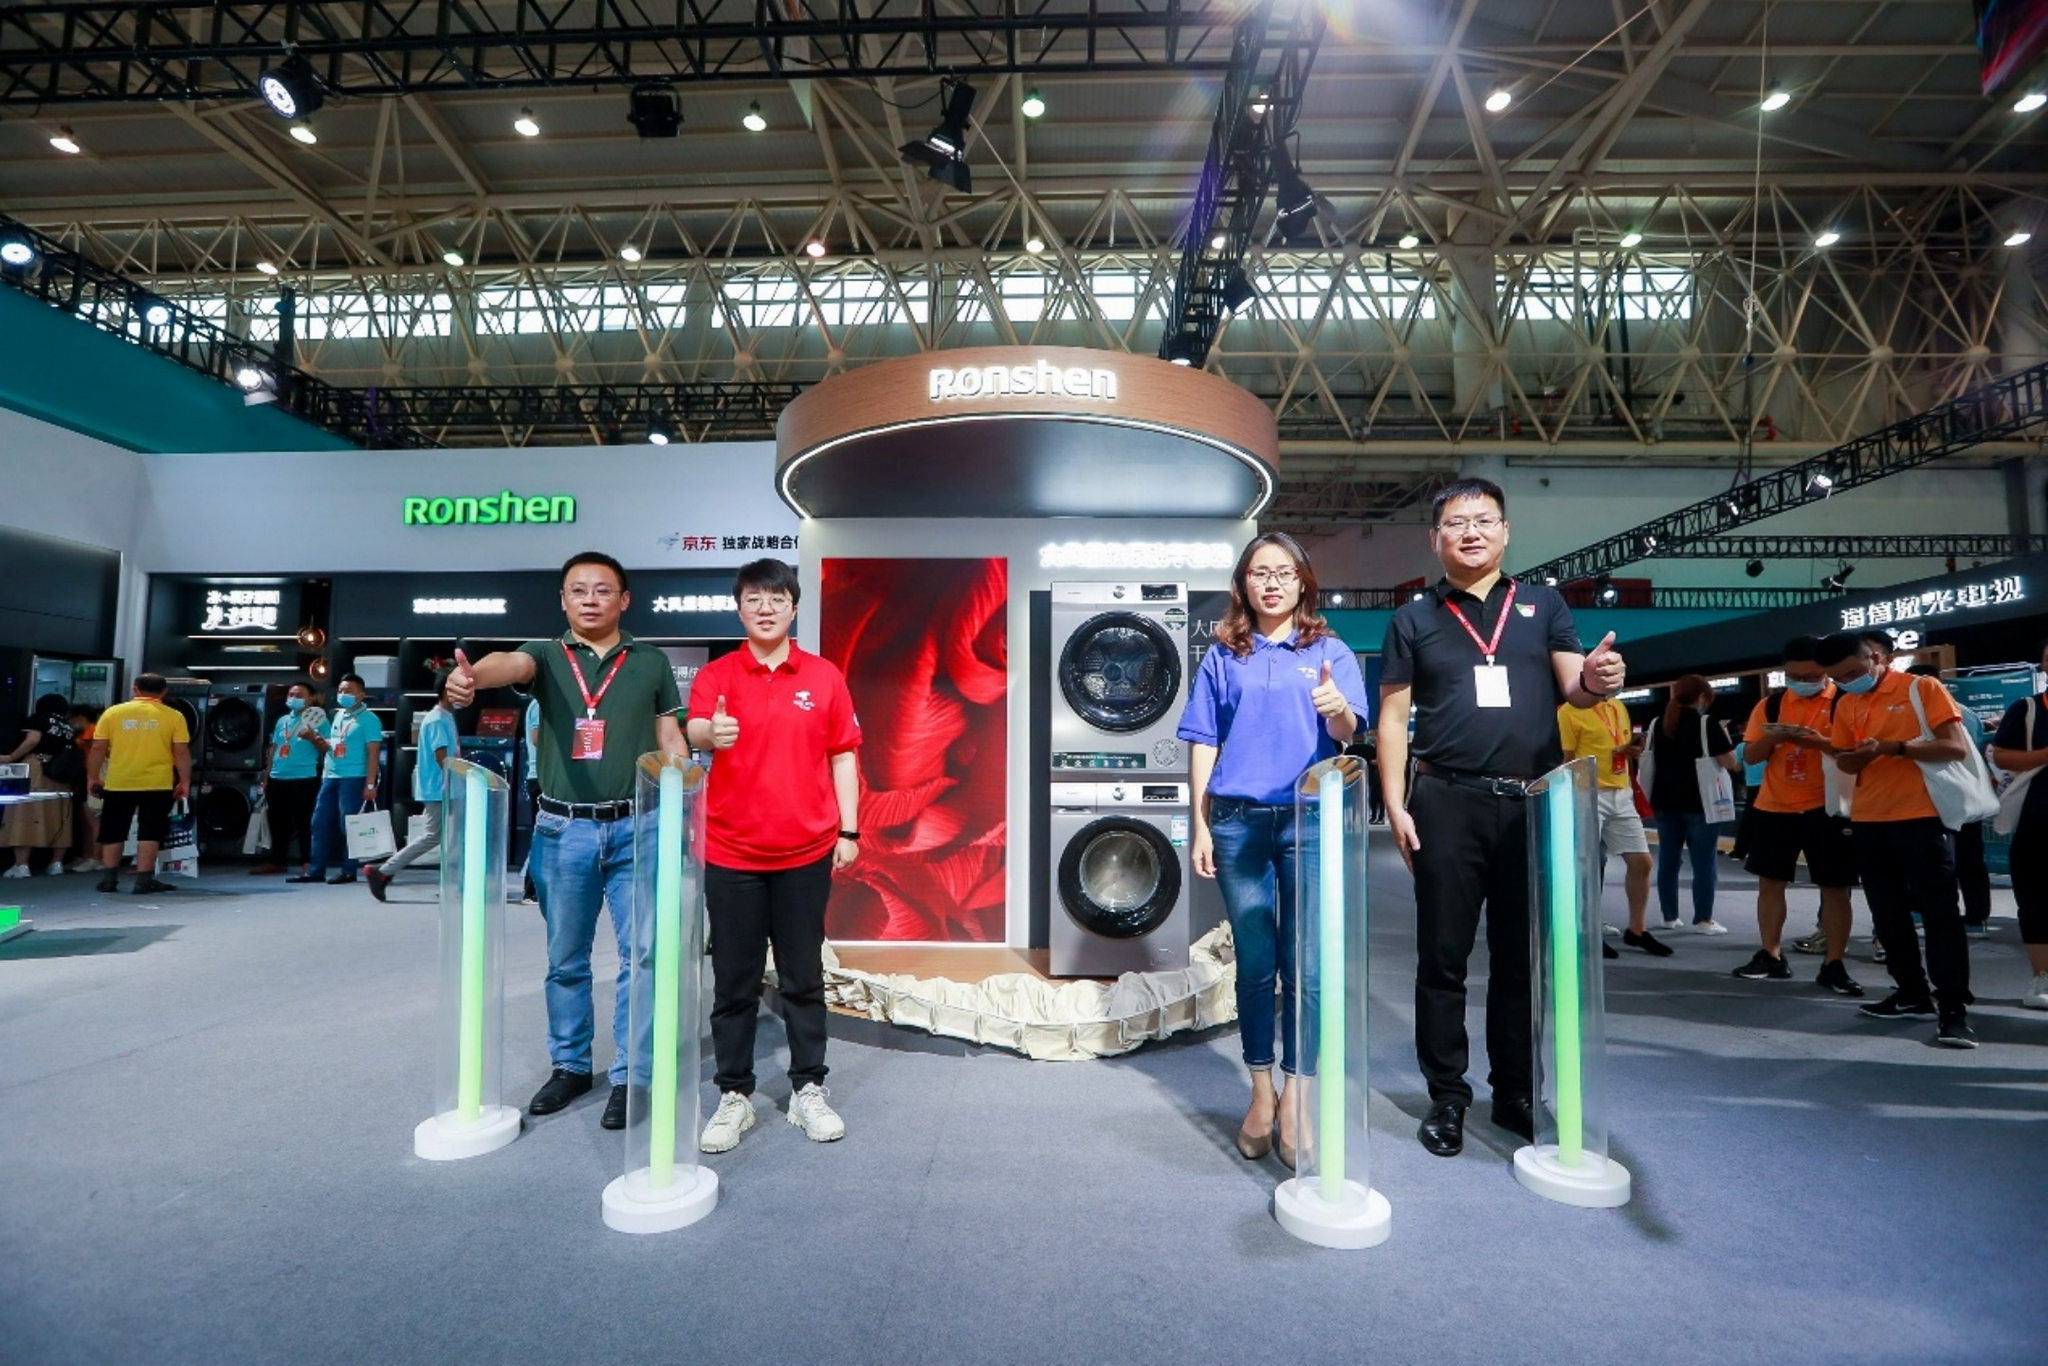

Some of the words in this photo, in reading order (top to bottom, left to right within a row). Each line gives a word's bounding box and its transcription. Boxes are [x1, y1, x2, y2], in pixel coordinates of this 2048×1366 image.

[682, 535, 717, 551] 京东
[722, 535, 799, 550] 独家战略合
[1840, 575, 2026, 631] 海信激光电视
